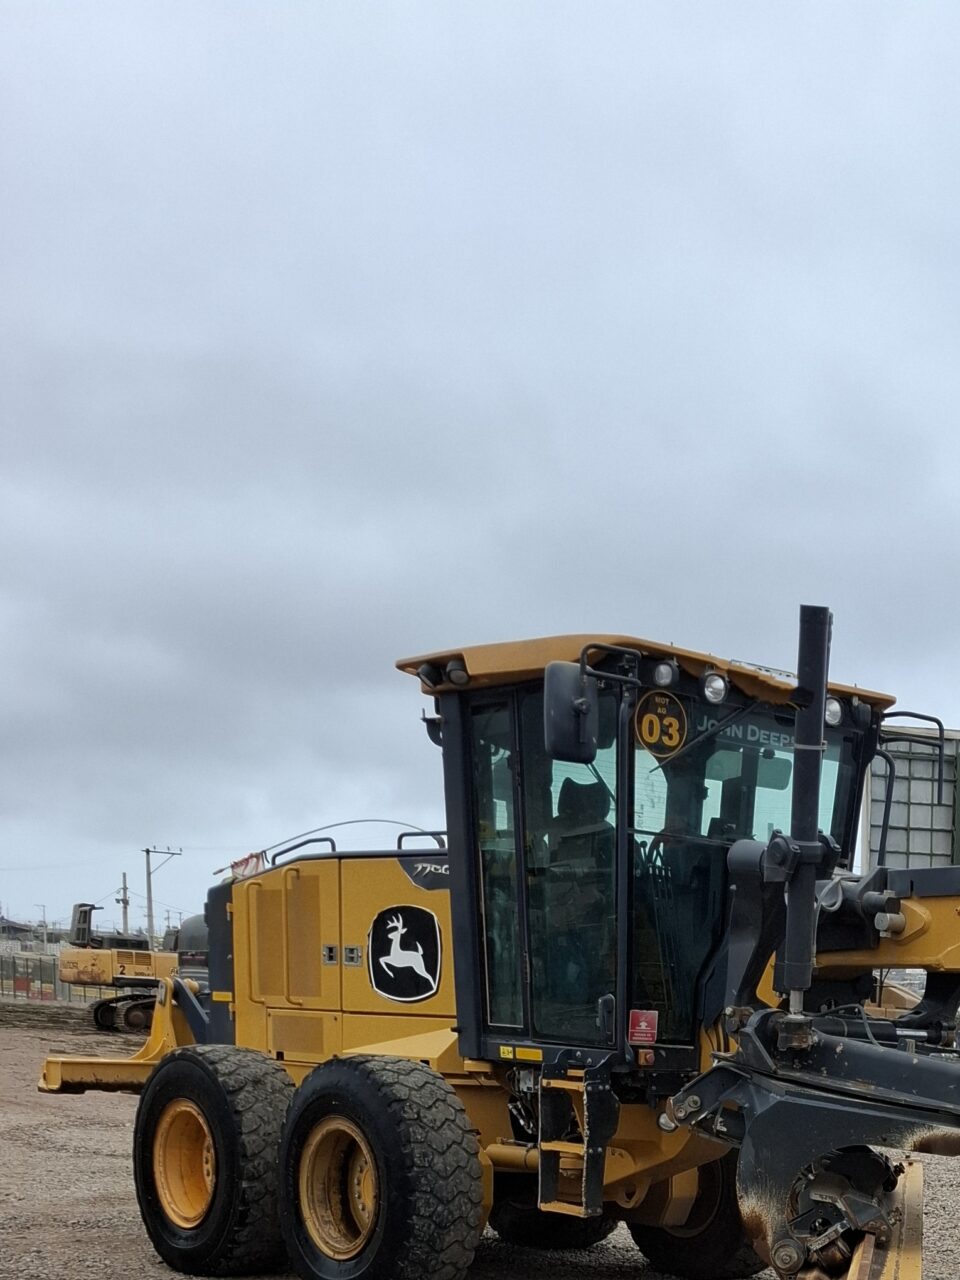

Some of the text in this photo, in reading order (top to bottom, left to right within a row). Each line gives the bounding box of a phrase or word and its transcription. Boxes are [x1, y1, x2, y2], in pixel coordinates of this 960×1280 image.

[641, 713, 681, 747] 03
[747, 725, 795, 747] DEER
[119, 964, 126, 976] 2
